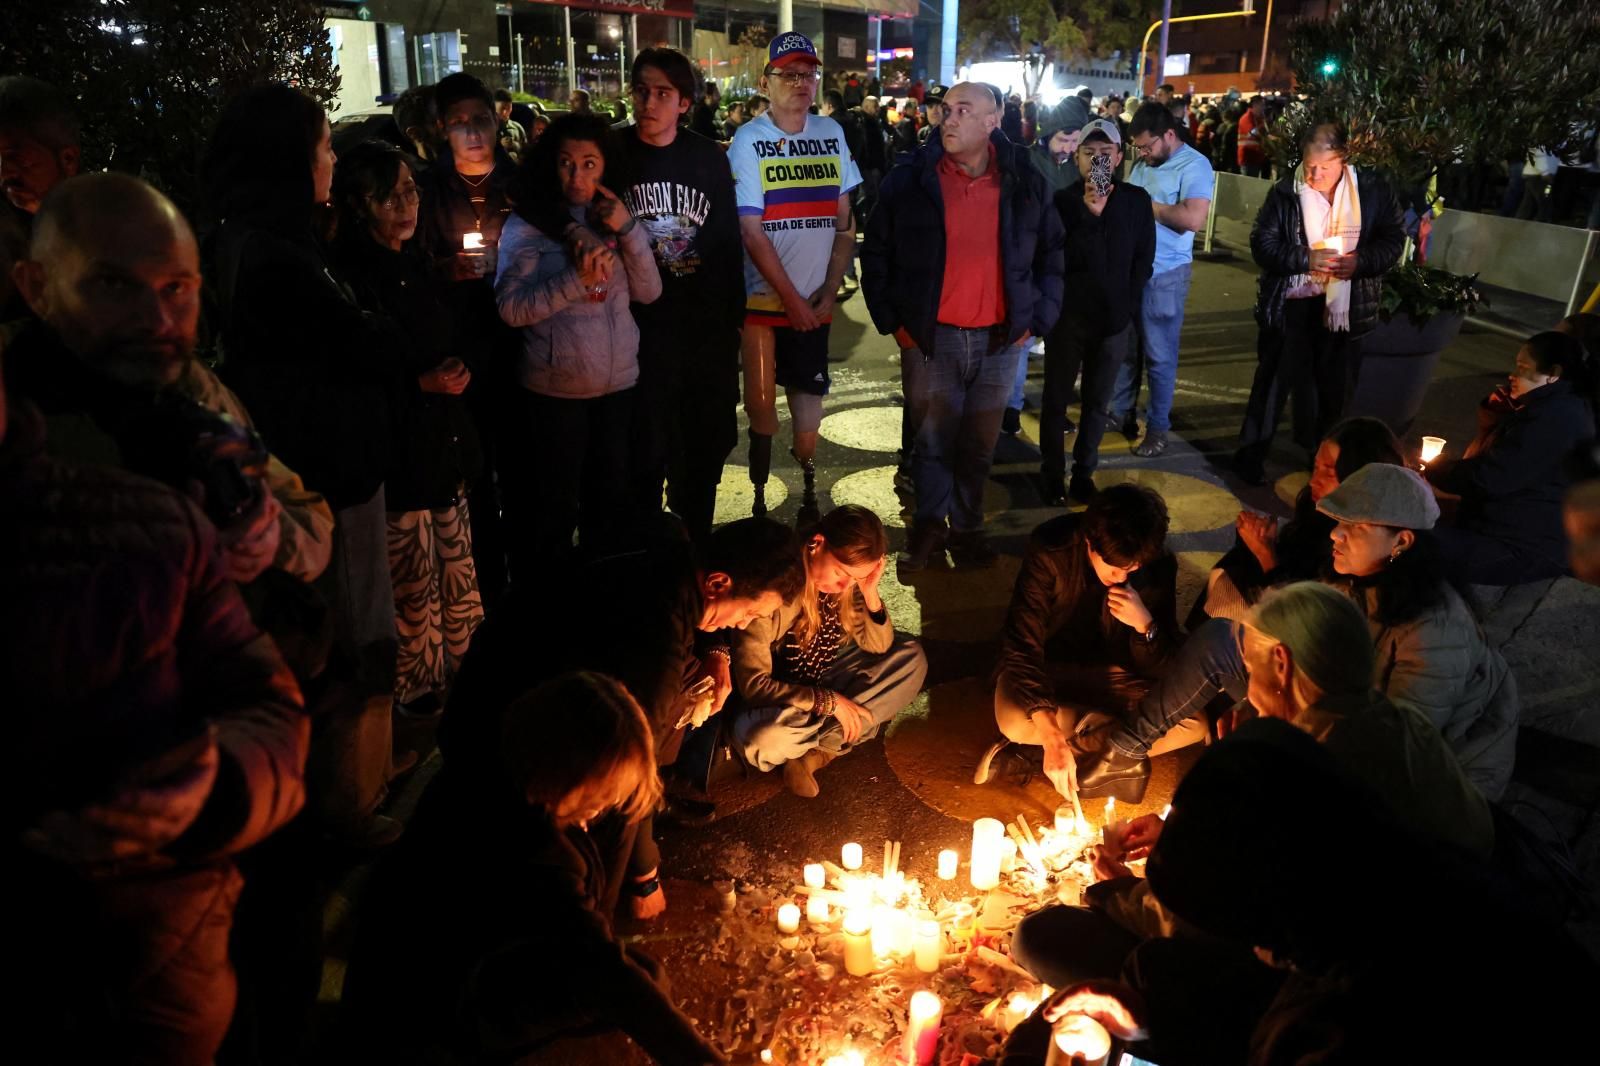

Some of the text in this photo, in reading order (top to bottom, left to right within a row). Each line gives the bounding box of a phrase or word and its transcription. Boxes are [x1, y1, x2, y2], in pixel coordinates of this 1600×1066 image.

[776, 41, 813, 54] ADOLFO
[789, 138, 839, 157] ADOLFO
[766, 162, 838, 182] COLOMBIA
[676, 183, 711, 227] FALLS
[791, 220, 804, 230] DE
[806, 218, 830, 229] GENTE
